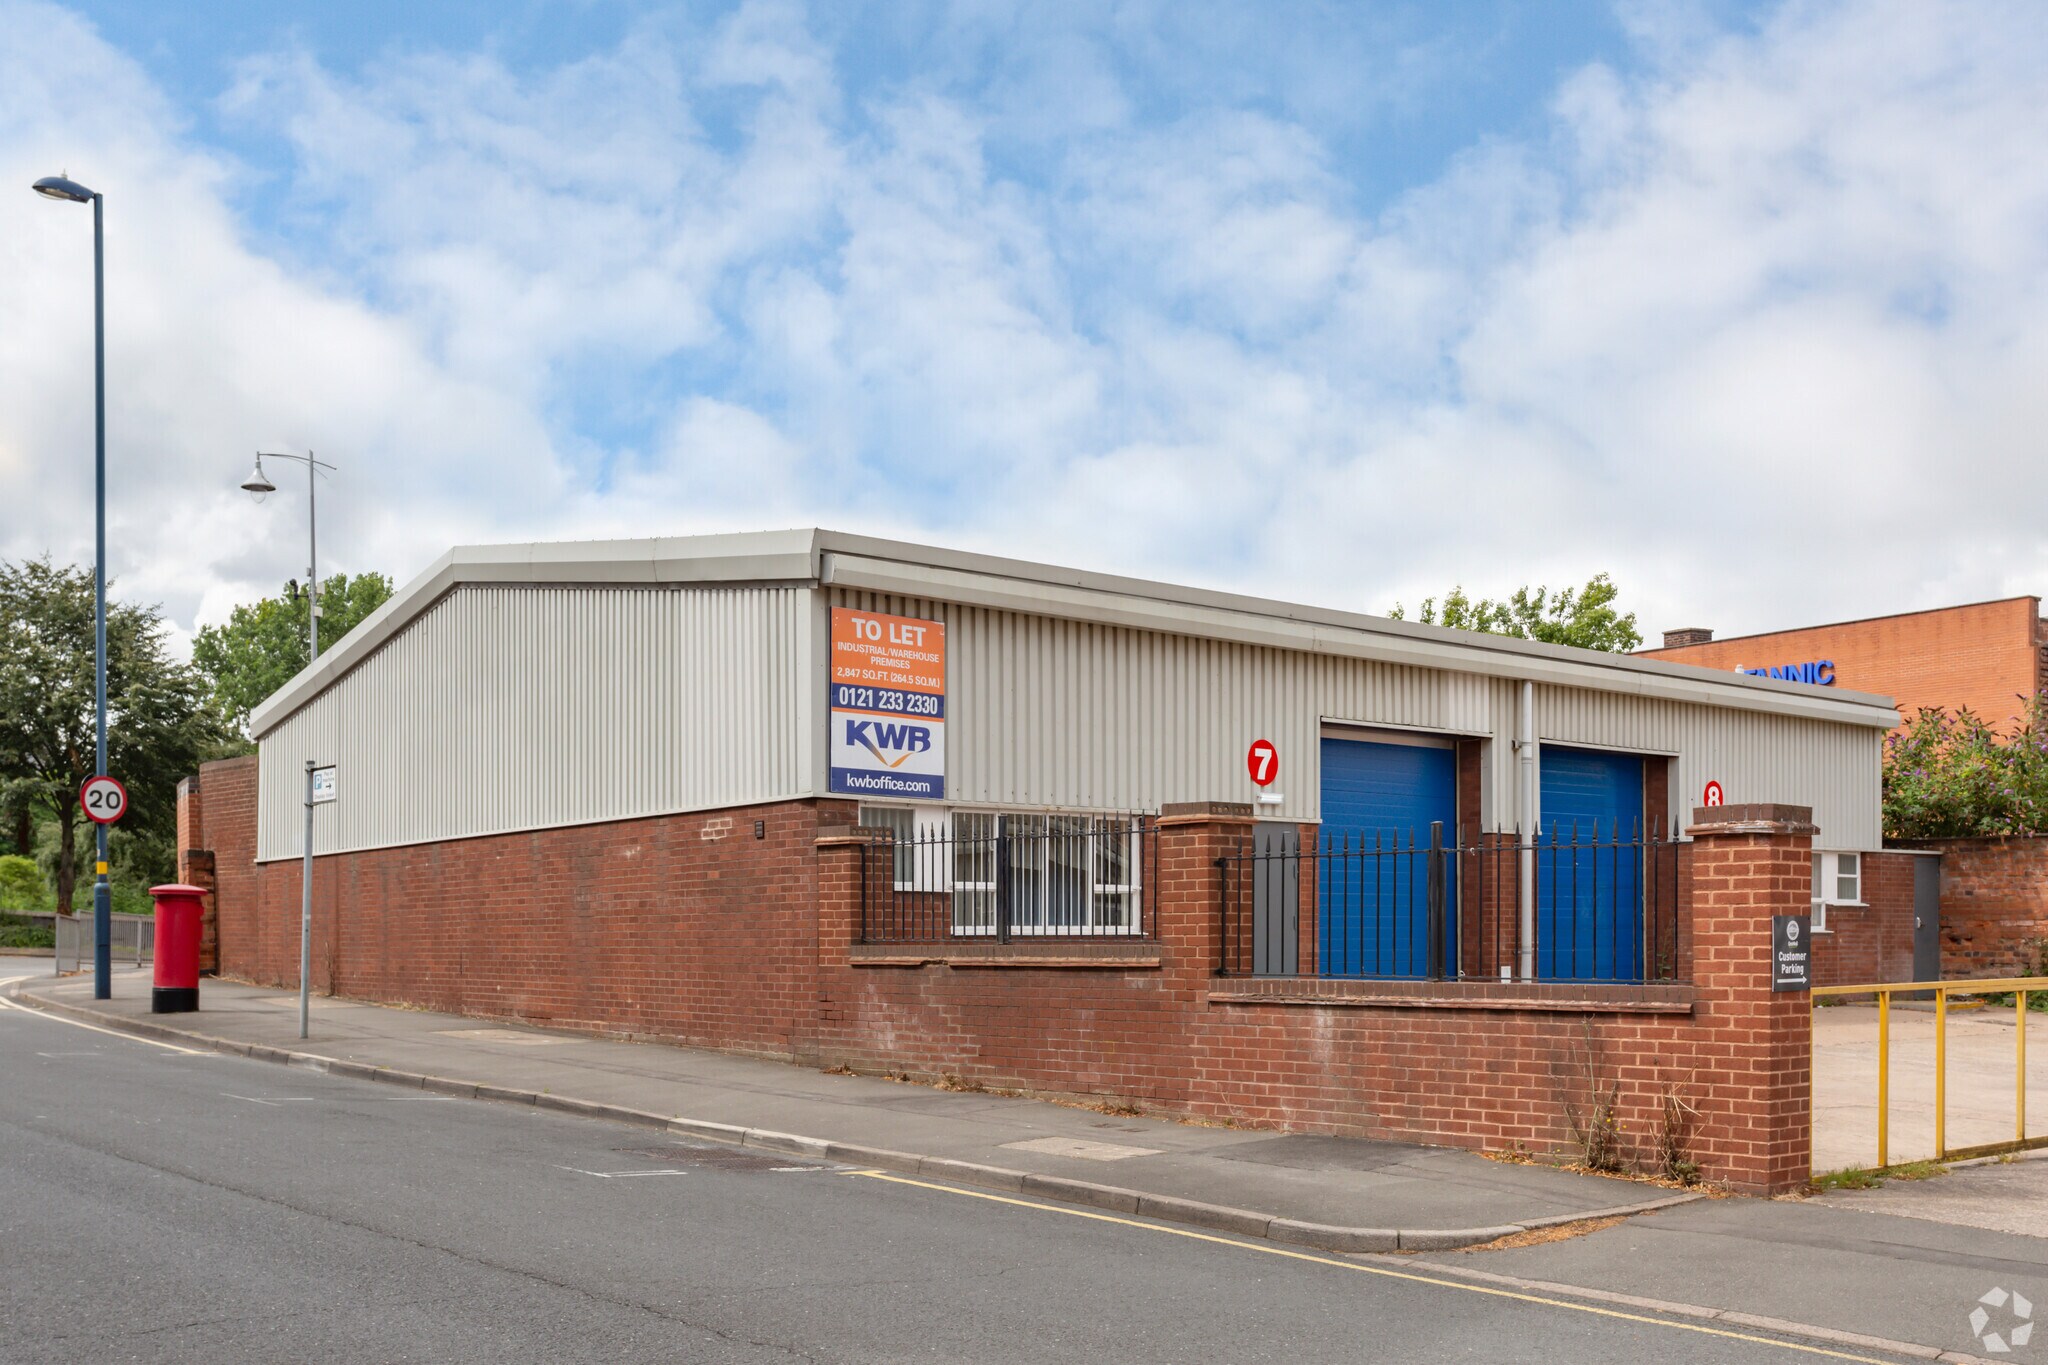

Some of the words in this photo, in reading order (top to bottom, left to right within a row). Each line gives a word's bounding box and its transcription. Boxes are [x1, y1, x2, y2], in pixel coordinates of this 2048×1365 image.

[851, 617, 882, 641] TO
[889, 623, 926, 647] LET
[837, 641, 939, 663] INDUSTRIAL/WAREHOUSE
[837, 667, 861, 678] 2,847
[870, 656, 910, 669] PREMISES
[1743, 660, 1836, 685] NNIC
[839, 686, 873, 707] 0121
[878, 690, 904, 711] 233
[906, 694, 938, 715] 2330
[846, 719, 931, 755] KWB
[1254, 747, 1272, 780] 7
[847, 773, 930, 793] kwboffice.com
[88, 790, 121, 810] 20
[1708, 786, 1720, 806] 8
[1778, 951, 1807, 961] Customer
[1781, 963, 1804, 975] Parking
